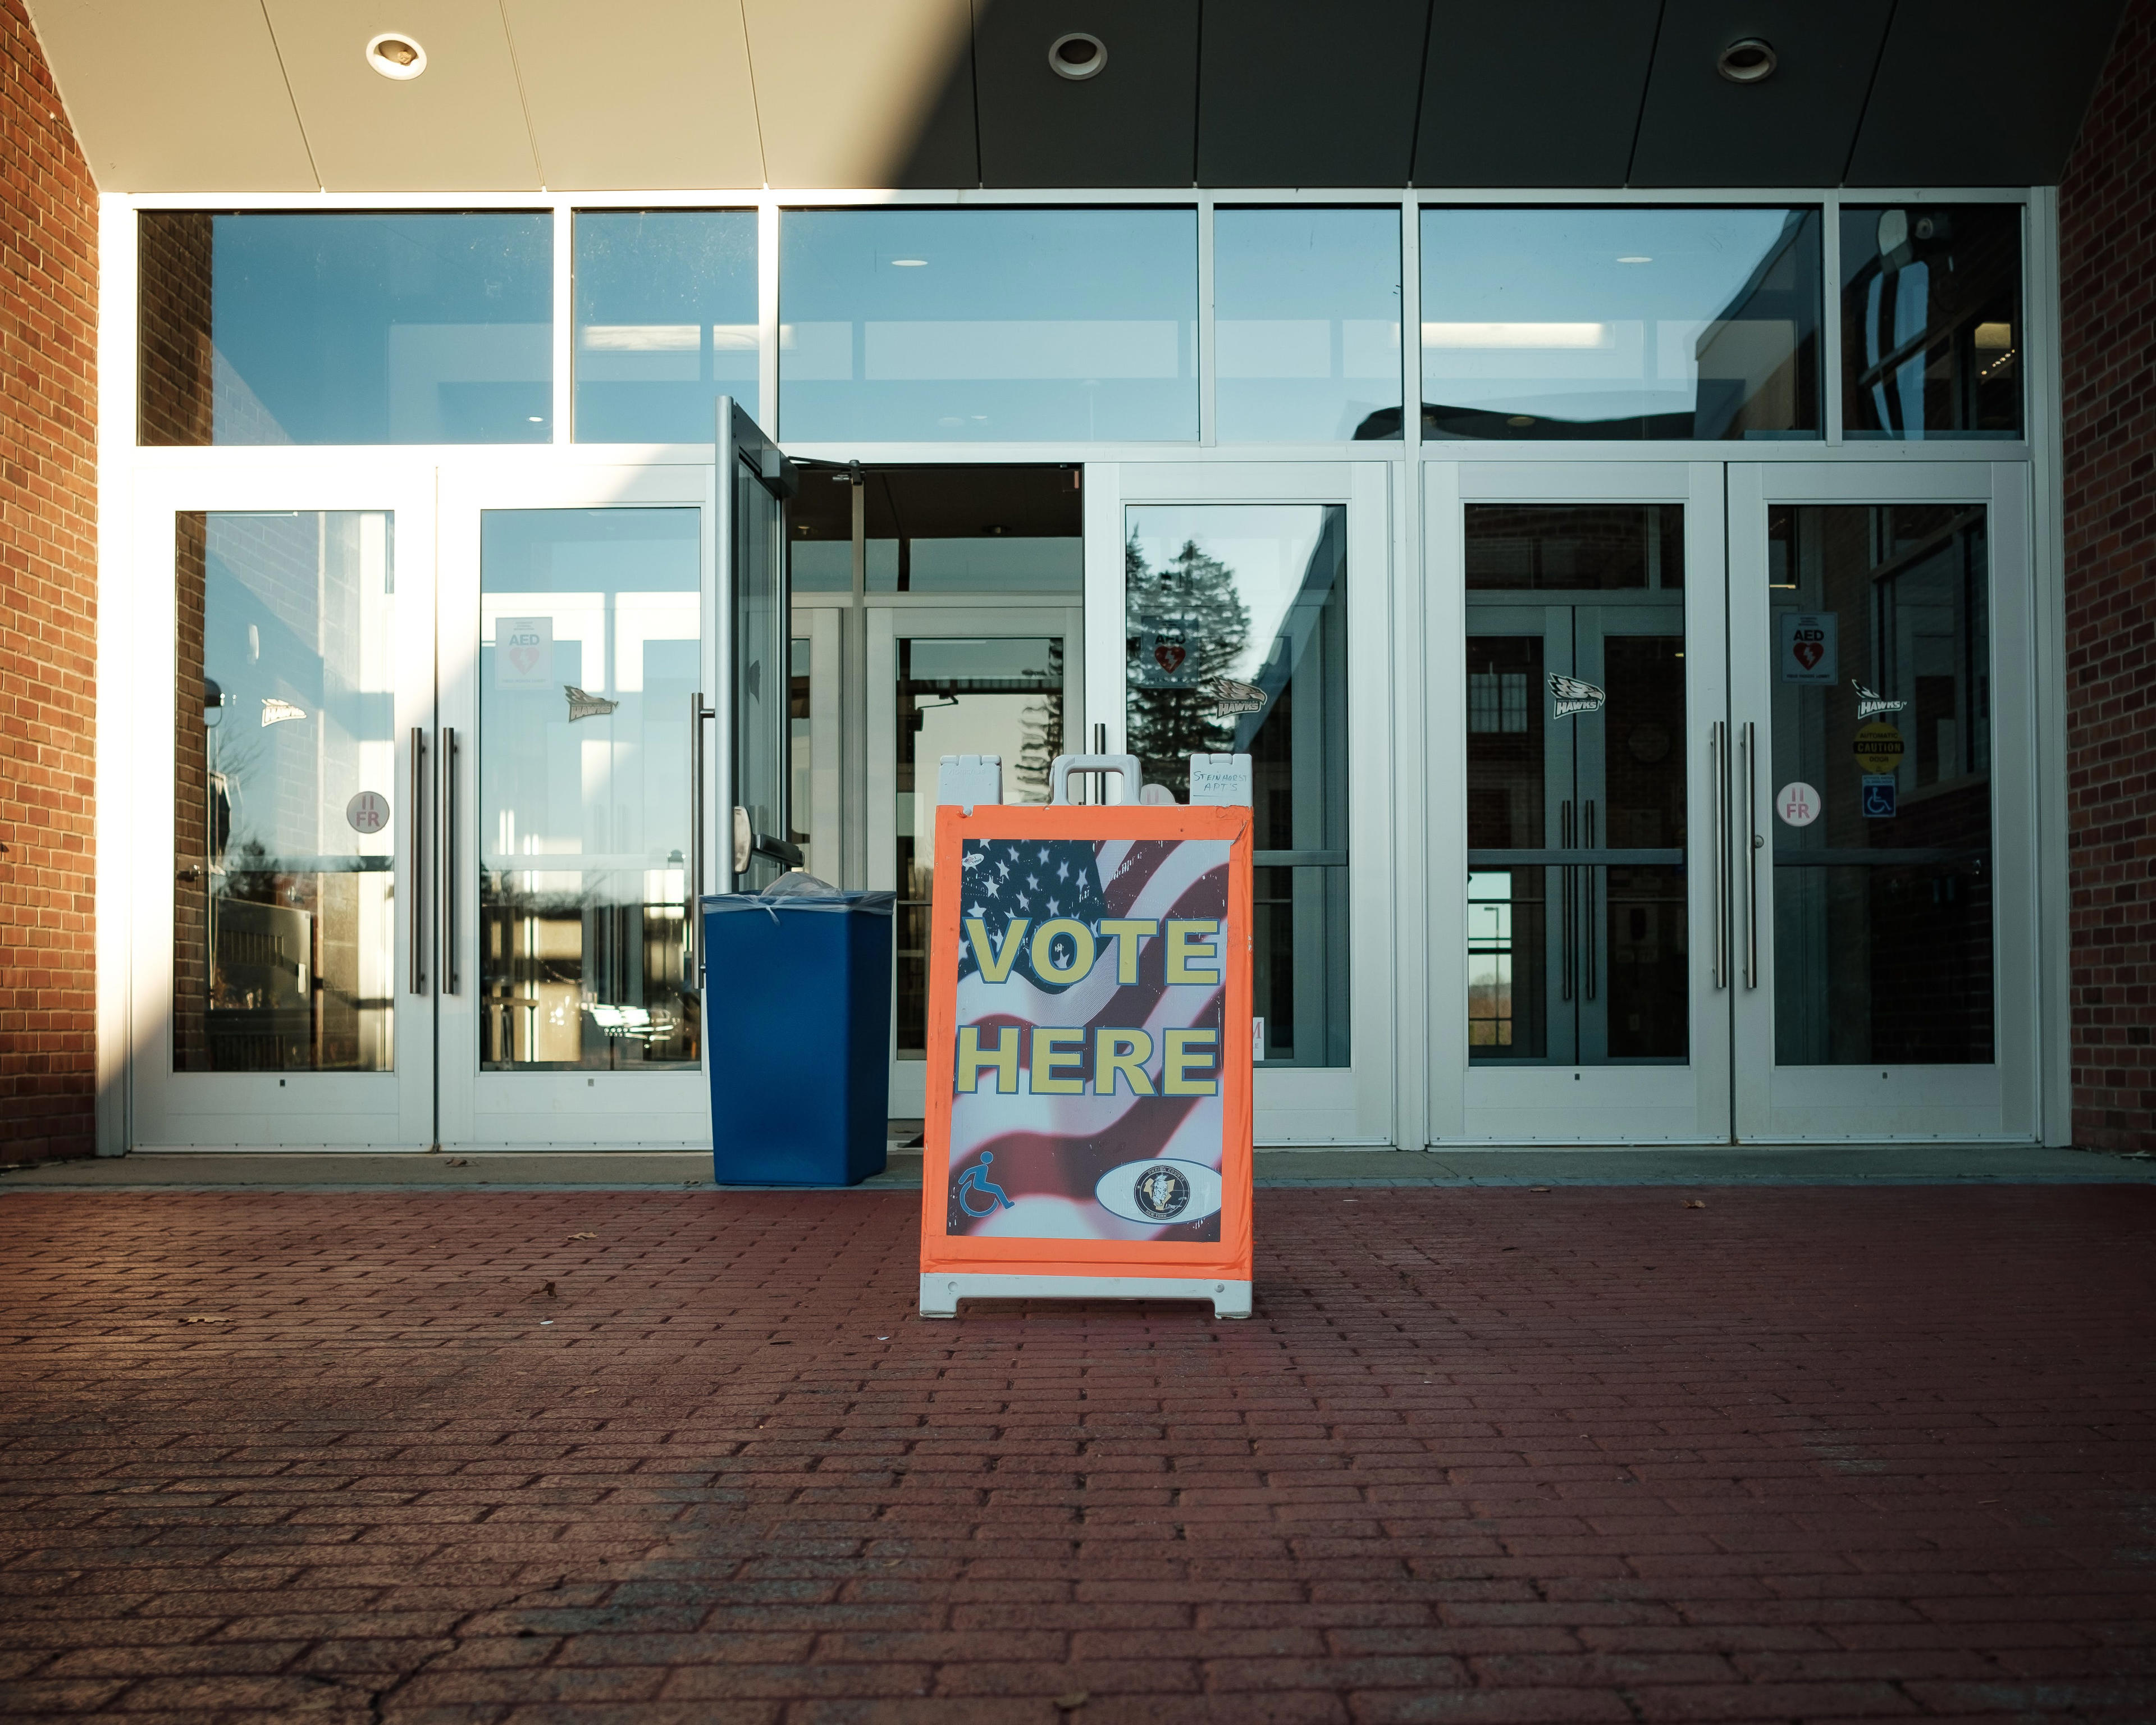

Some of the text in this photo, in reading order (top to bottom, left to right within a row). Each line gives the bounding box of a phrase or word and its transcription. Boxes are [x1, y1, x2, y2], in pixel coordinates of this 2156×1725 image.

[509, 634, 540, 646] AED
[1793, 629, 1824, 641] AED
[571, 706, 611, 719] HAWKS
[1218, 702, 1258, 717] HAWKS
[1556, 701, 1597, 715] HAWKS
[1861, 701, 1901, 715] HAWKS
[1857, 742, 1901, 753] CAUTION
[1204, 783, 1237, 791] APT'S
[1787, 804, 1810, 819] FR
[356, 812, 380, 827] FR
[962, 917, 1221, 986] VOTE
[954, 1025, 1219, 1097] HERE
